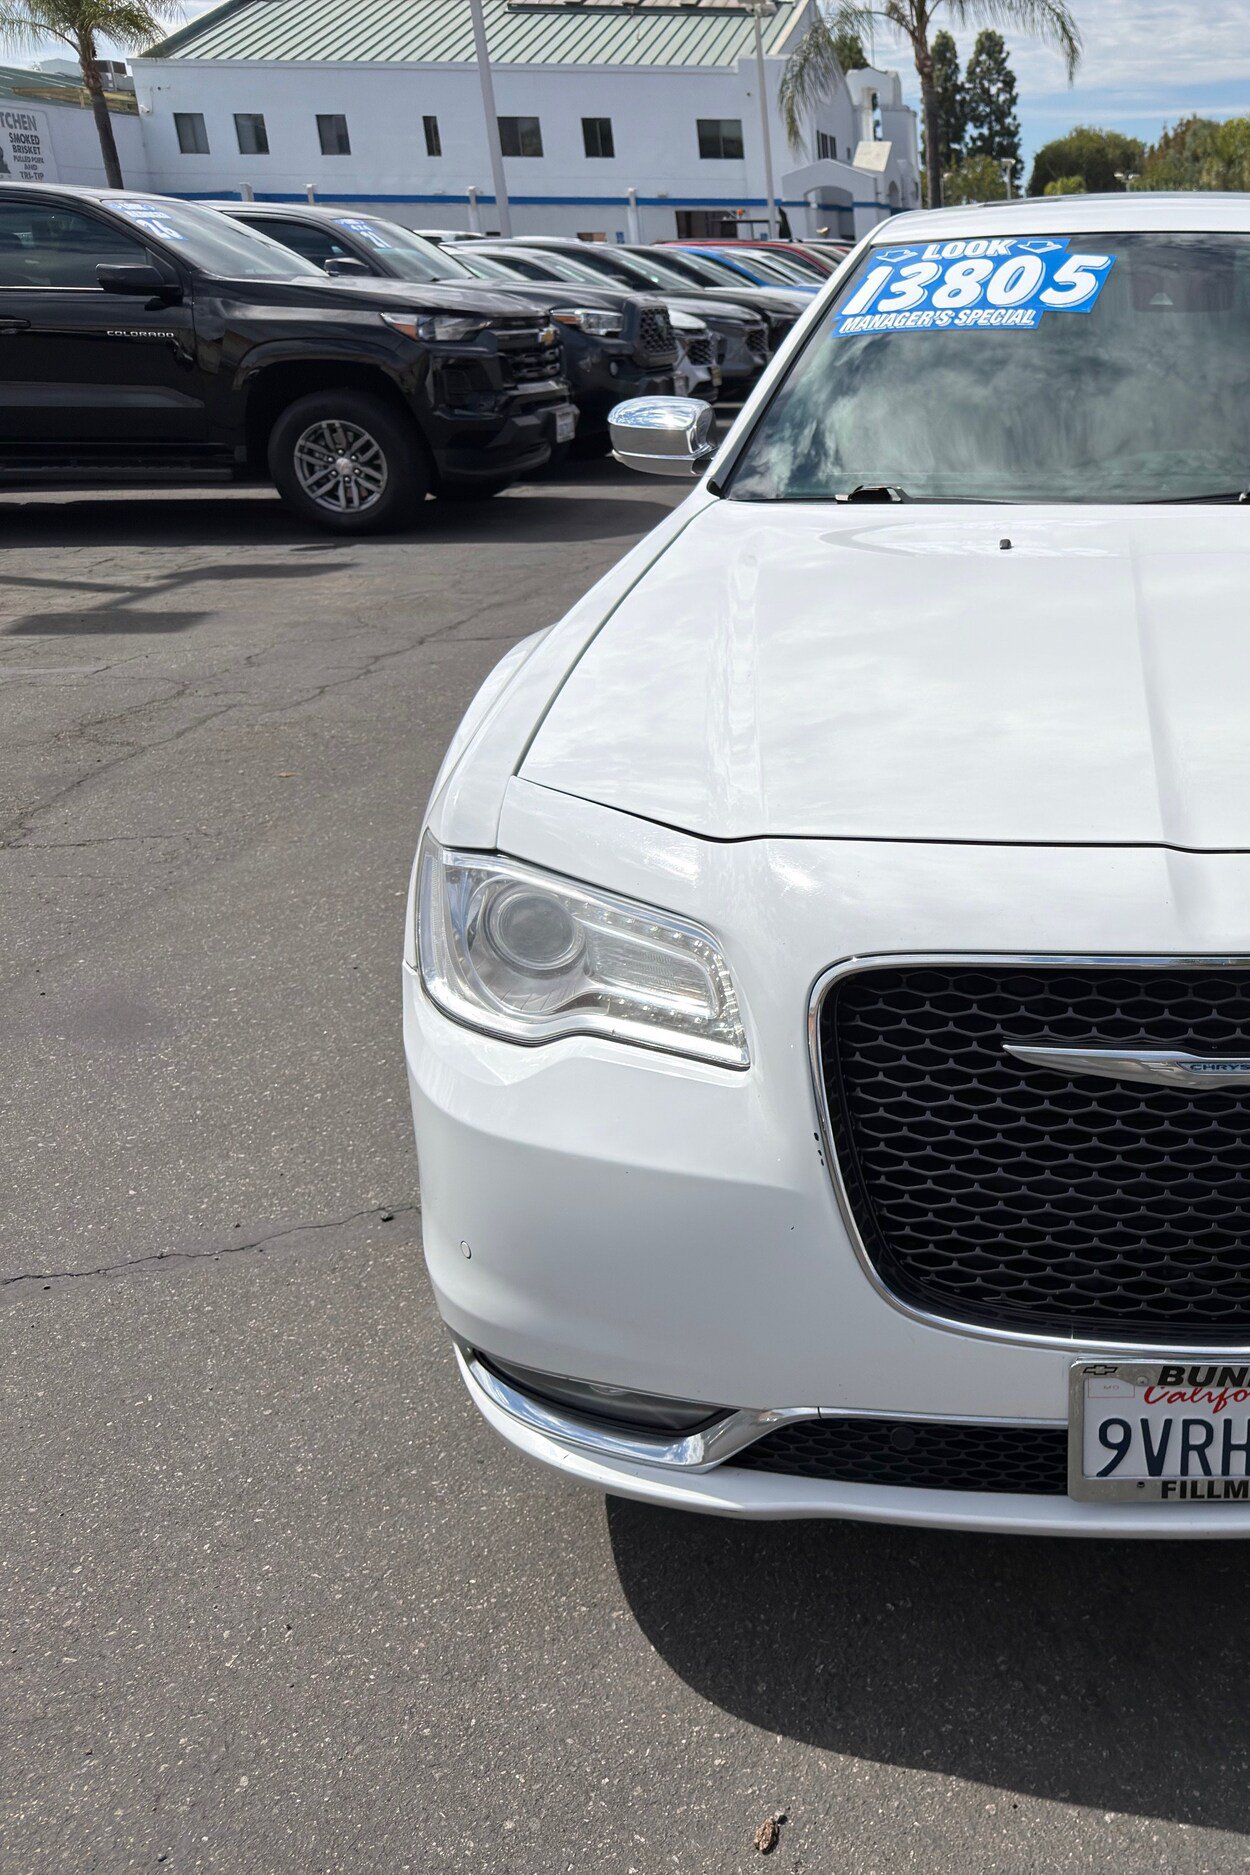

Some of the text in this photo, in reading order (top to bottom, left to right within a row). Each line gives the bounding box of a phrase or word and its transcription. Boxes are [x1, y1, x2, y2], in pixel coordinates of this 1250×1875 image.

[9, 132, 40, 145] SMOKED
[12, 144, 41, 155] BRISKET
[19, 171, 45, 180] TRI-TIP
[921, 239, 1017, 261] LOOK
[841, 255, 1112, 316] 13805
[839, 308, 1037, 334] MANAGER'S SPECIAL
[106, 330, 175, 338] COLORADO
